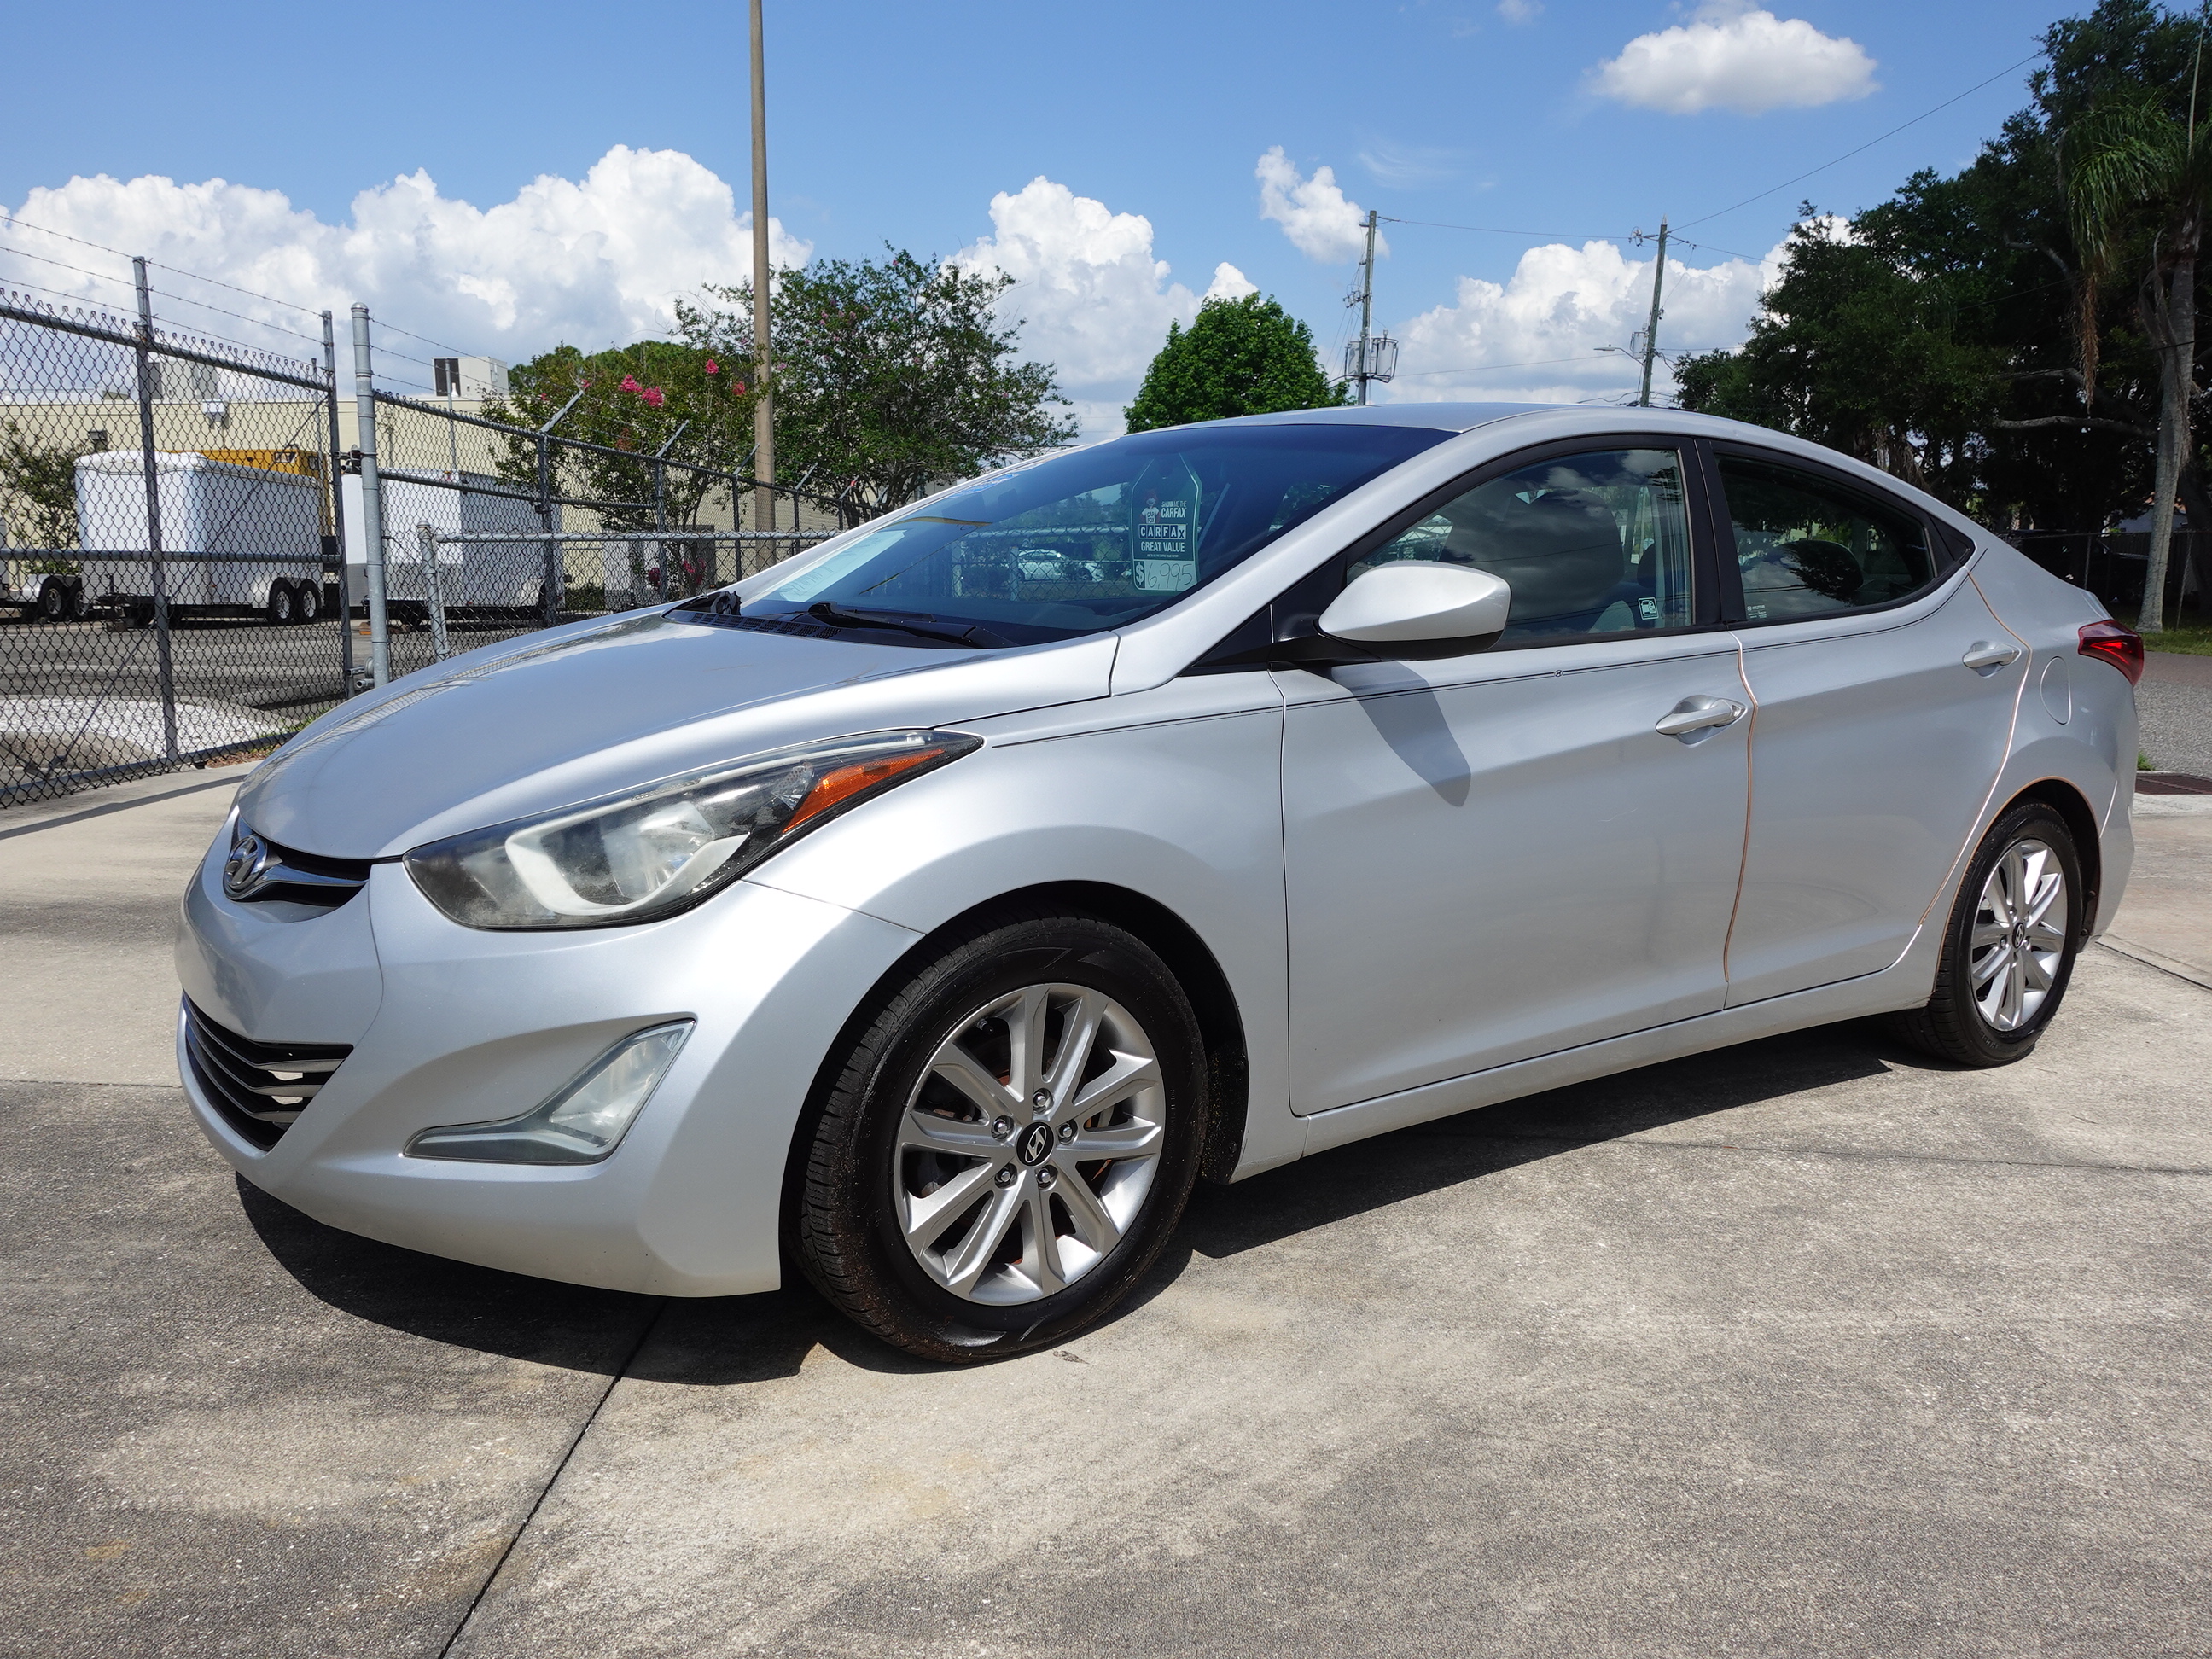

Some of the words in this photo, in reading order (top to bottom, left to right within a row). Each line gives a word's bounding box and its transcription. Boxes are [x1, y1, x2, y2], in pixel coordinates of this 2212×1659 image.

[1161, 508, 1186, 518] CARFAX
[1140, 527, 1185, 538] CARFAX
[1141, 541, 1162, 552] GREAT
[1163, 542, 1185, 552] VALUE
